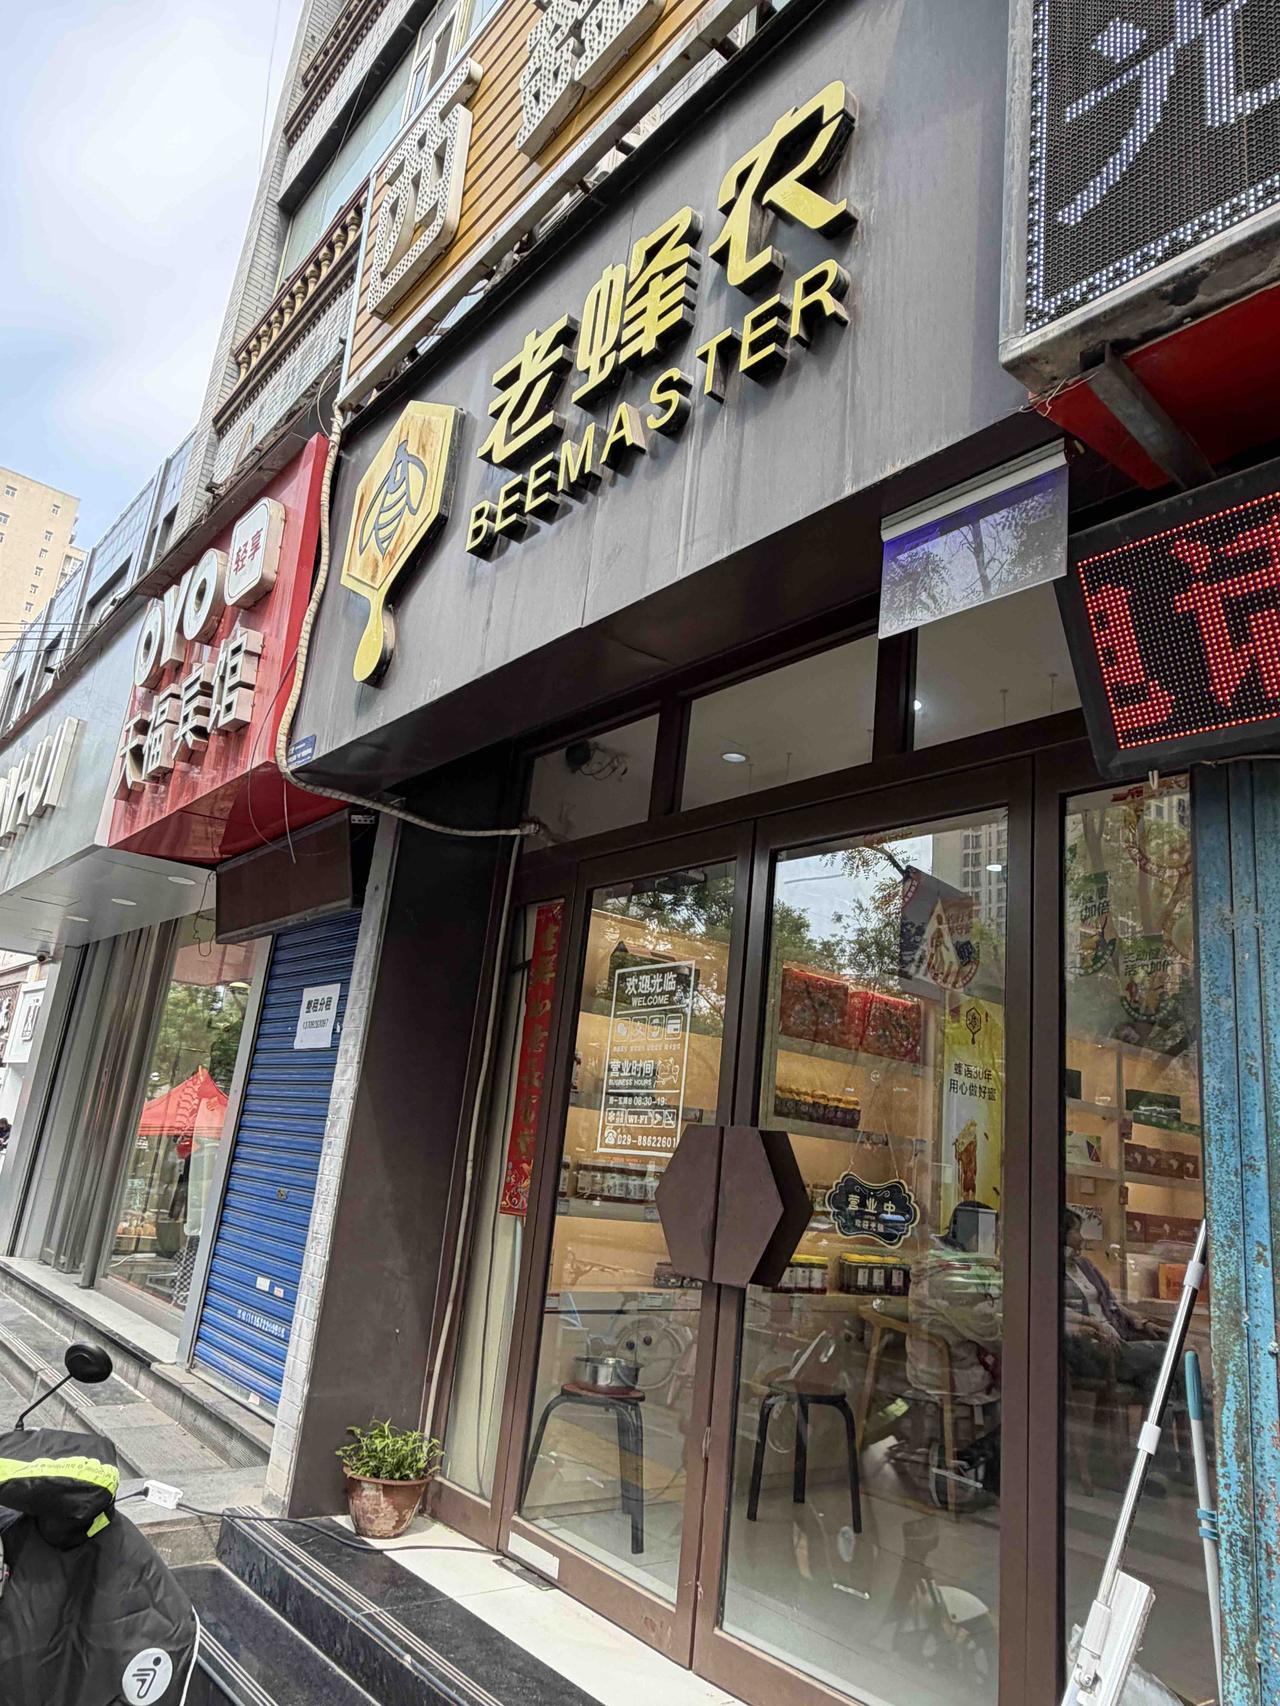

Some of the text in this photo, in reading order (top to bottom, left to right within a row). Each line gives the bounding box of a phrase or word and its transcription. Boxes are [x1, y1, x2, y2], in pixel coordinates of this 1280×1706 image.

[477, 81, 850, 466] 老蜂农
[465, 259, 846, 560] BEEMASTER
[233, 527, 263, 576] 轻享
[133, 548, 224, 688] OYO
[113, 627, 258, 800] 天福宾馆
[624, 971, 677, 995] 欢迎光临
[631, 995, 669, 1007] WELCOME
[608, 1058, 654, 1077] 营业时间
[608, 1079, 652, 1087] BUSINESS HOURS
[848, 1193, 897, 1216] 营业中
